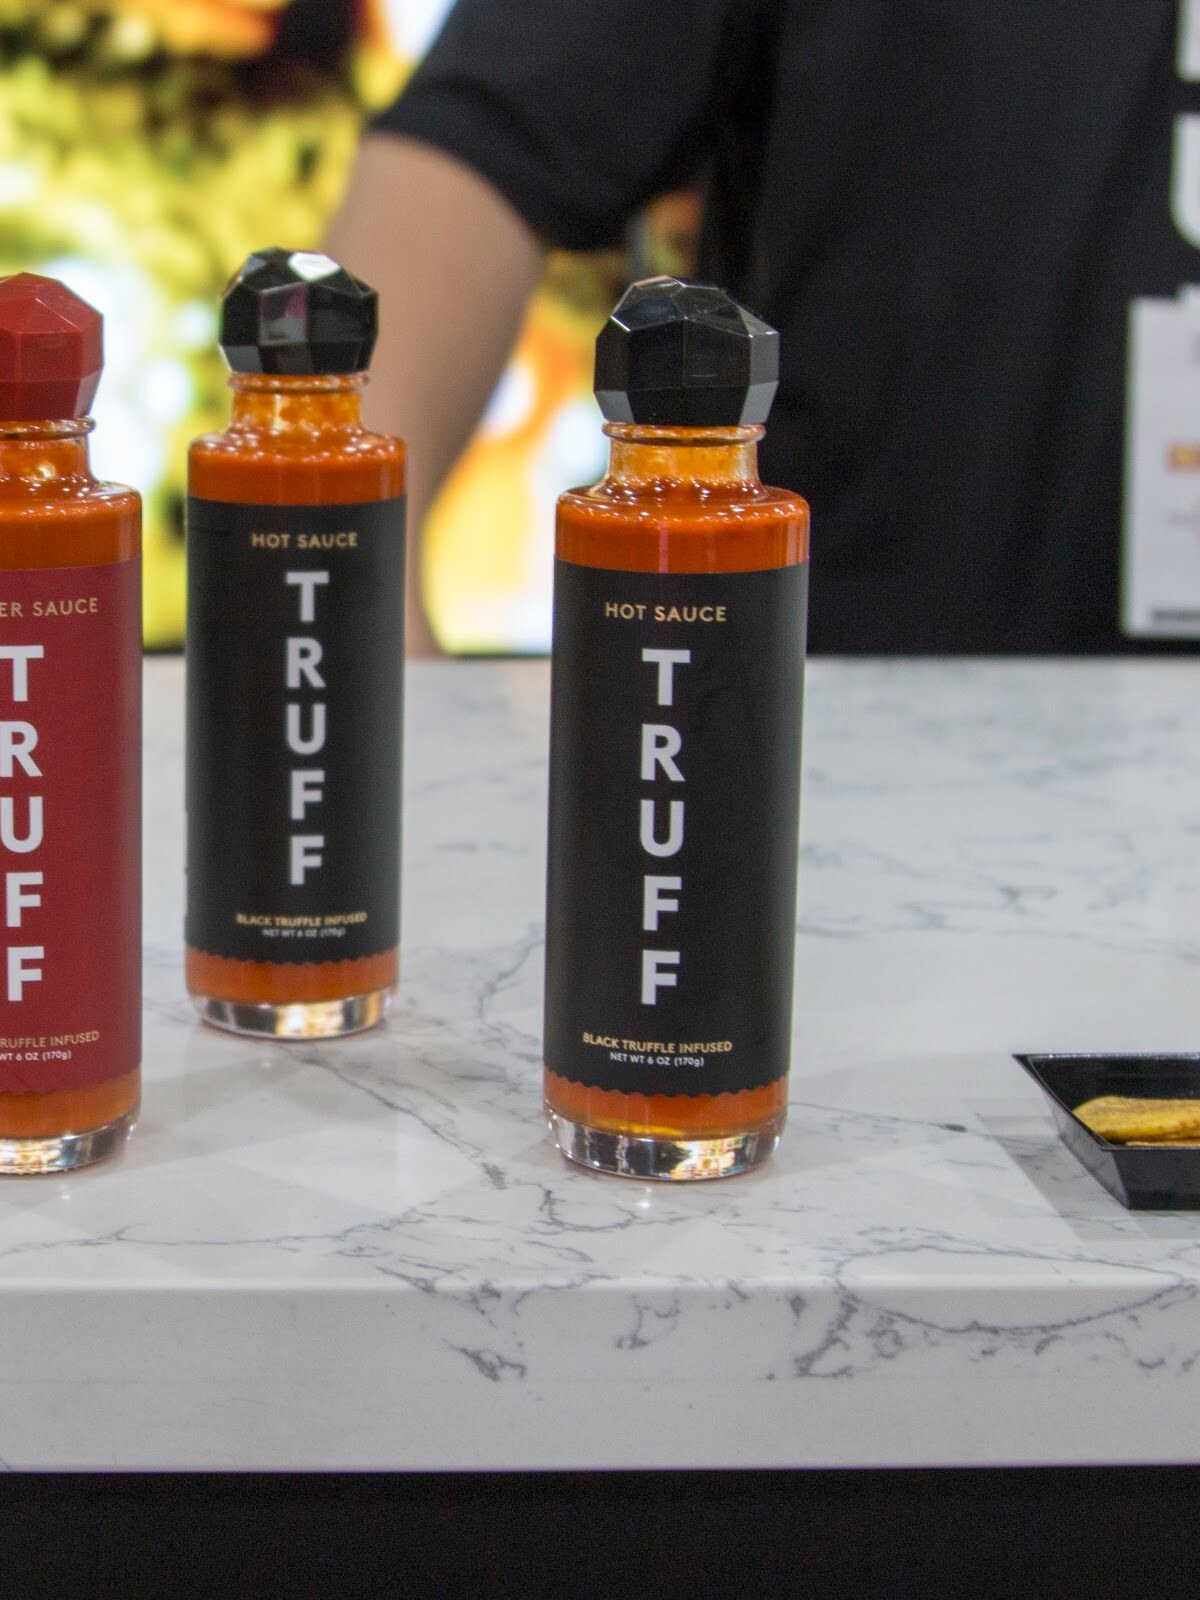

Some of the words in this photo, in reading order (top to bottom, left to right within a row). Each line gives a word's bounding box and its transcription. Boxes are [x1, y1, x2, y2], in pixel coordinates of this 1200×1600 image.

[251, 532, 291, 549] HOT
[296, 530, 358, 550] SAUCE
[31, 596, 99, 618] SAUCE
[604, 601, 647, 622] HOT
[652, 604, 727, 623] SAUCE
[284, 569, 331, 887] TRUFF
[638, 646, 692, 1007] TRUFF
[50, 1030, 100, 1047] INFUSED
[582, 1031, 620, 1049] BLACK
[621, 1038, 676, 1054] TRUFFLE
[679, 1040, 733, 1054] INFUSED
[15, 1052, 23, 1061] 6
[25, 1052, 40, 1061] OZ
[42, 1050, 72, 1062] (170g)
[609, 1052, 628, 1063] NET
[630, 1054, 645, 1064] WT
[647, 1056, 654, 1065] 6
[656, 1056, 671, 1066] OZ
[673, 1056, 705, 1068] (170g)
